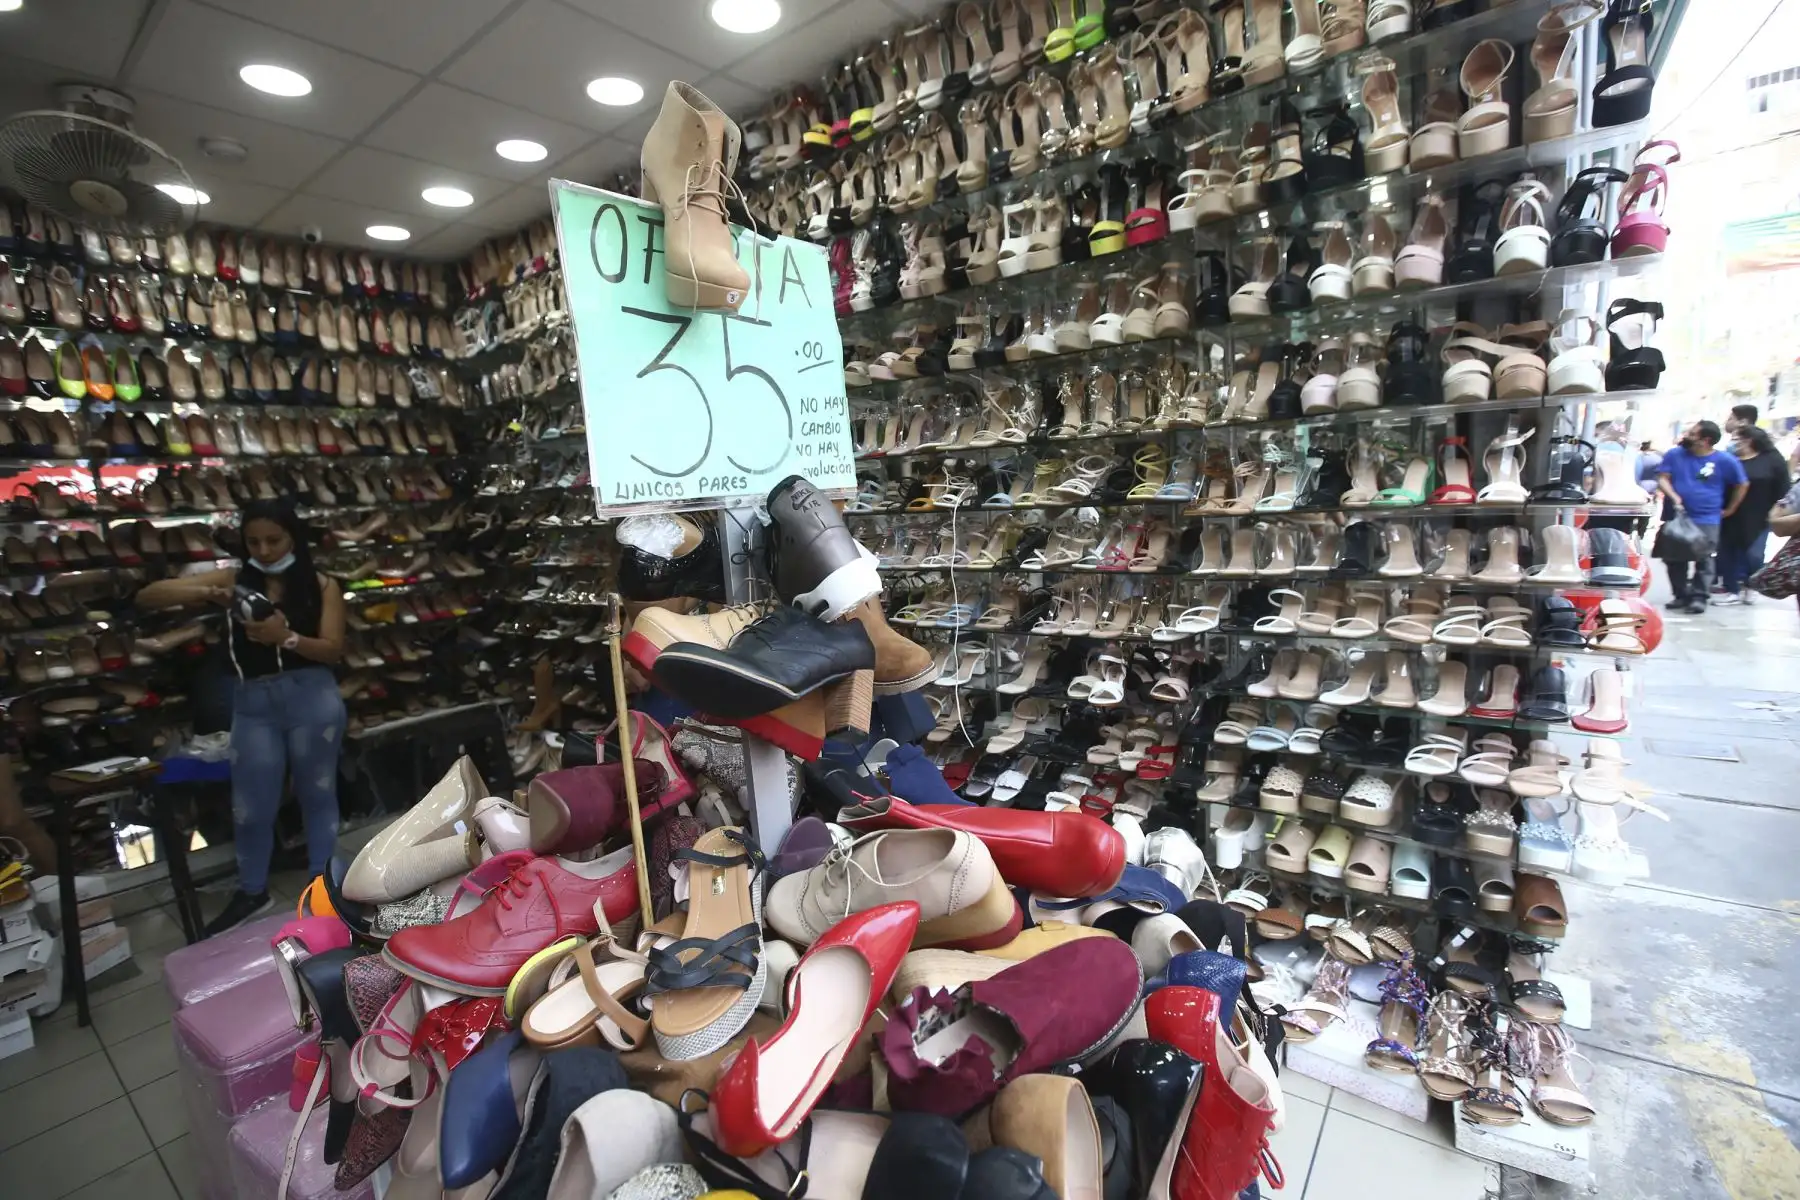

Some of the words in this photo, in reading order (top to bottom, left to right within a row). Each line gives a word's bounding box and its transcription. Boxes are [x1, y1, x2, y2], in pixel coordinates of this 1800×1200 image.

[590, 203, 812, 309] OFTA
[621, 305, 794, 478] 35
[800, 397, 818, 415] NO
[824, 395, 845, 416] HAY
[801, 421, 841, 437] CAMBIO
[818, 440, 840, 459] HAY
[699, 475, 748, 494] PARES
[802, 499, 821, 513] AIR
